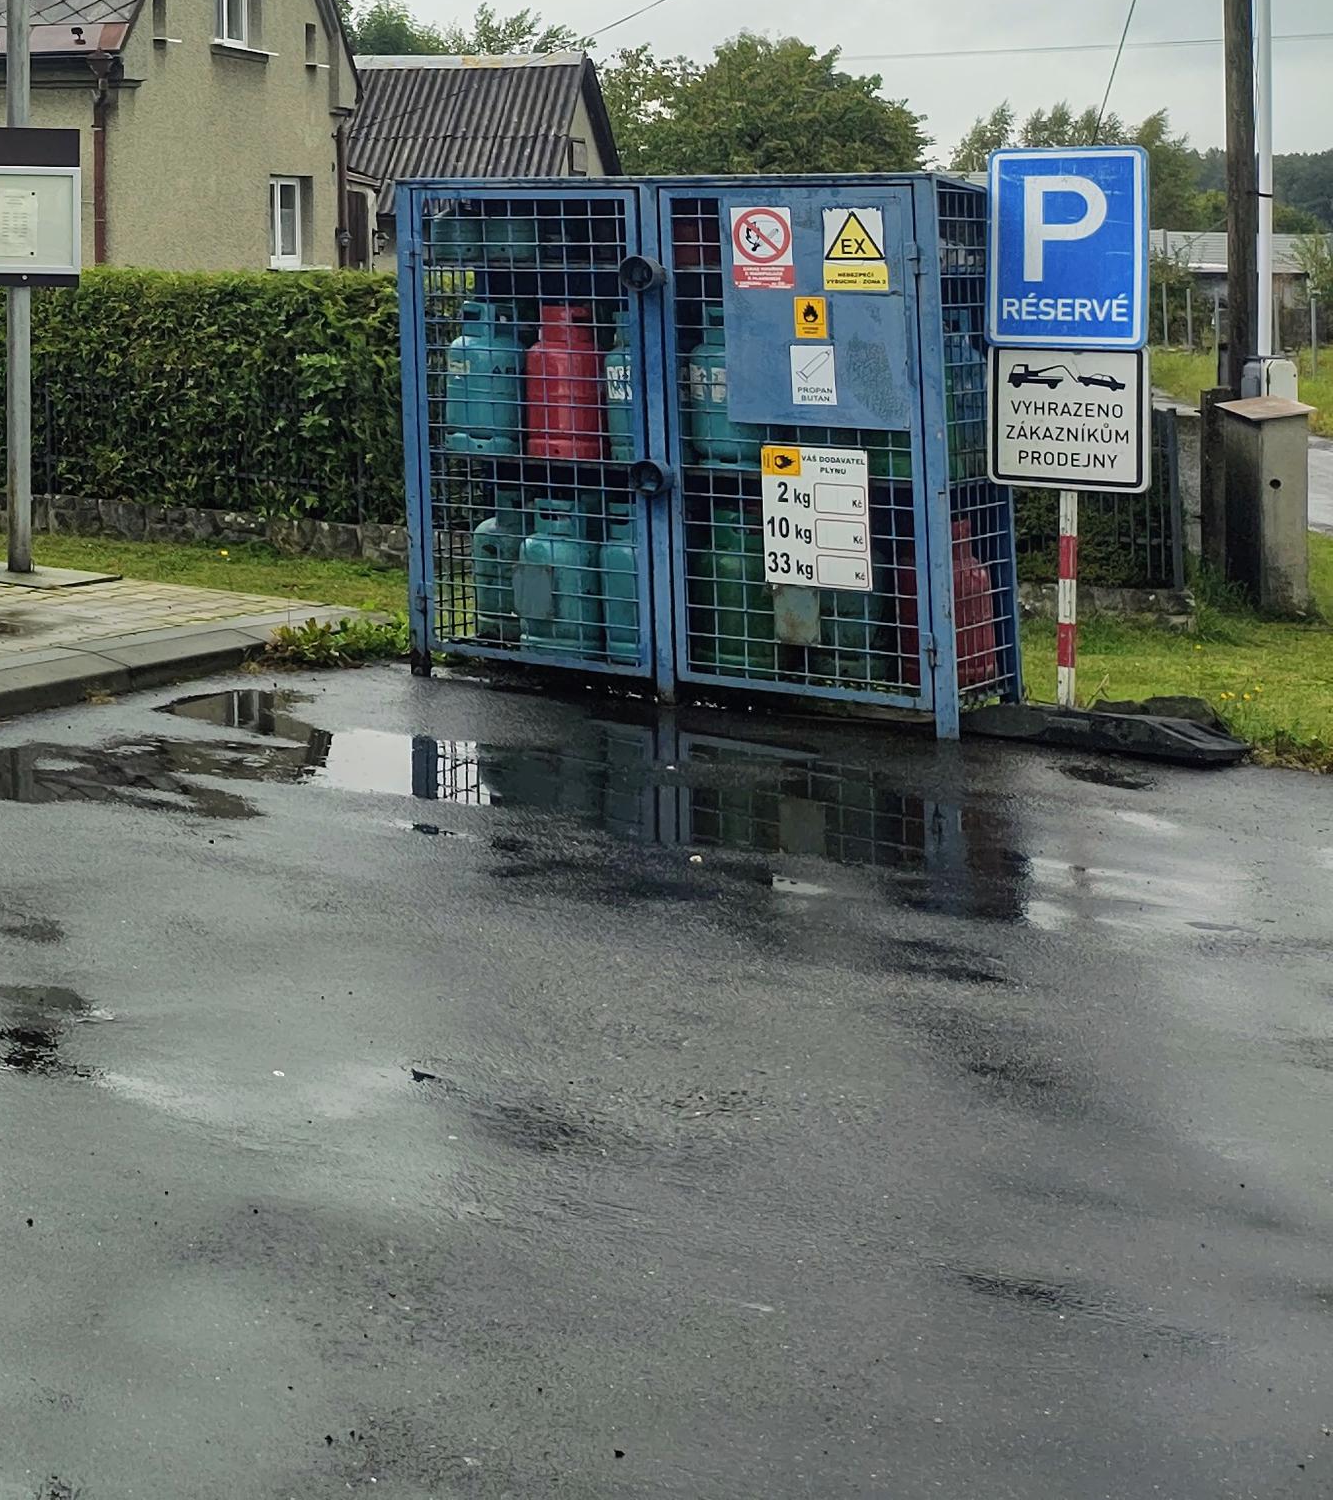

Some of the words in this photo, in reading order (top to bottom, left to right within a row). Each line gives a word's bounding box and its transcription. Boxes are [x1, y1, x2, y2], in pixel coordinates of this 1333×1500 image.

[1023, 175, 1107, 282] P
[841, 238, 867, 255] EX
[1002, 292, 1129, 322] RÉSERVÉ
[797, 386, 833, 394] PROPAN
[801, 394, 830, 402] BUTAN
[1010, 400, 1124, 419] VYHRAZENO
[1005, 420, 1129, 445] ZÁKAZNÍKŮM
[819, 456, 865, 465] DODAVATEL
[1018, 450, 1118, 469] PRODEJNY
[777, 481, 788, 503] 2
[793, 488, 811, 508] kg
[852, 499, 863, 508] Kč
[767, 516, 790, 538] 10
[795, 524, 812, 544] kg
[853, 535, 864, 544] Kč
[768, 551, 791, 574] 33
[796, 560, 813, 580] kg
[855, 571, 866, 580] Kč
